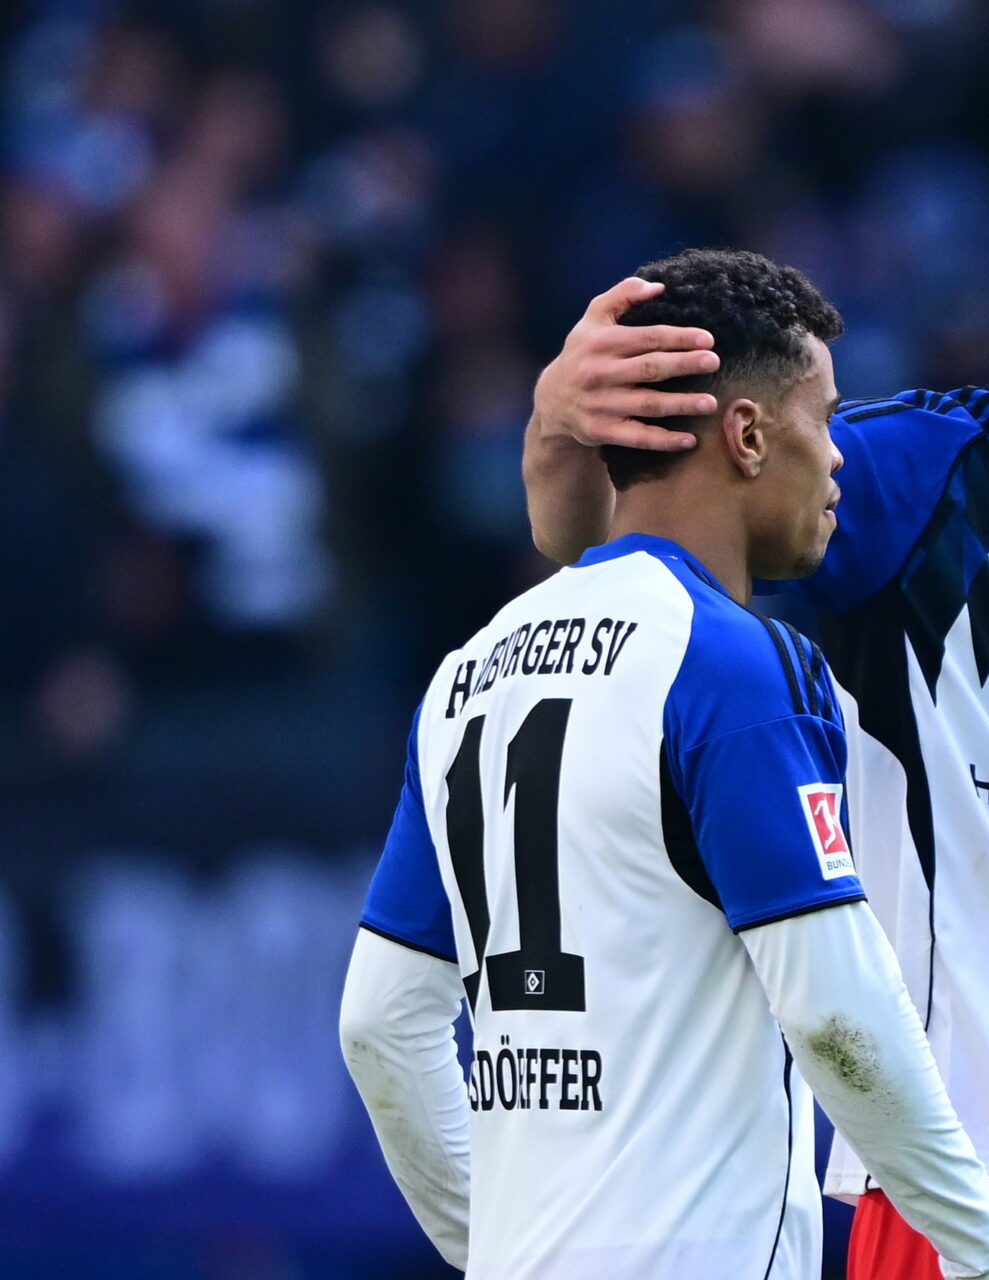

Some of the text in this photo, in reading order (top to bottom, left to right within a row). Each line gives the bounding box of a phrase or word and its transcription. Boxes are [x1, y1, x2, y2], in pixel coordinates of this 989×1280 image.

[445, 617, 639, 719] HBRGER SV
[445, 697, 586, 1013] 11
